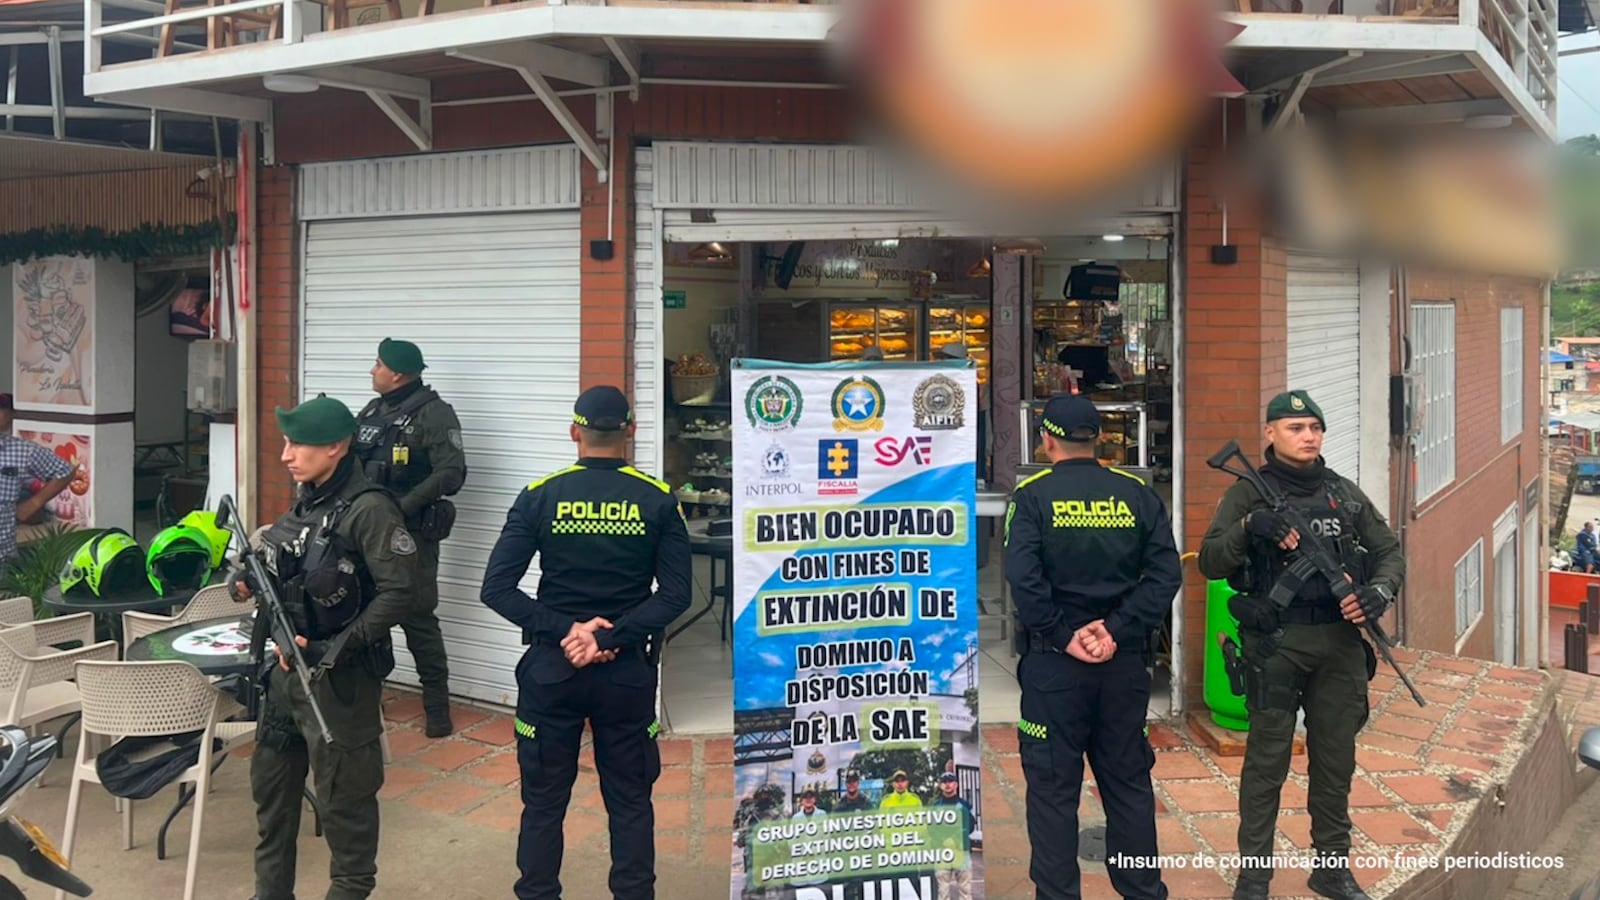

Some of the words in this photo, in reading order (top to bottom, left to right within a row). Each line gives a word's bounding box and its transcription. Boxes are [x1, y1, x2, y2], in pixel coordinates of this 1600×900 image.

[922, 415, 956, 426] AIFIT
[874, 436, 932, 467] SAE
[745, 482, 802, 497] INTERPOL
[557, 500, 641, 520] POLICÍA
[1052, 496, 1132, 516] POLICÍA
[757, 512, 817, 543] BIEN
[824, 508, 955, 540] OCUPADO
[1310, 518, 1341, 536] OES
[782, 556, 828, 580] CON
[834, 551, 895, 577] FINES
[901, 551, 929, 573] DE
[765, 585, 906, 627] EXTINCIÓN
[921, 590, 955, 618] DE
[798, 640, 894, 669] DOMINIO
[899, 639, 914, 661] A
[787, 669, 928, 705] DISPOSICIÓN
[793, 720, 823, 746] DE
[830, 715, 857, 743] LA
[872, 710, 928, 741] SAE
[757, 821, 818, 842] GRUPO
[823, 810, 957, 834] INVESTIGATIVO
[791, 831, 885, 857] EXTINCIÓN
[892, 831, 924, 846] DEL
[762, 857, 844, 881] DERECHO
[850, 855, 873, 870] DE
[878, 848, 954, 868] DOMINIO
